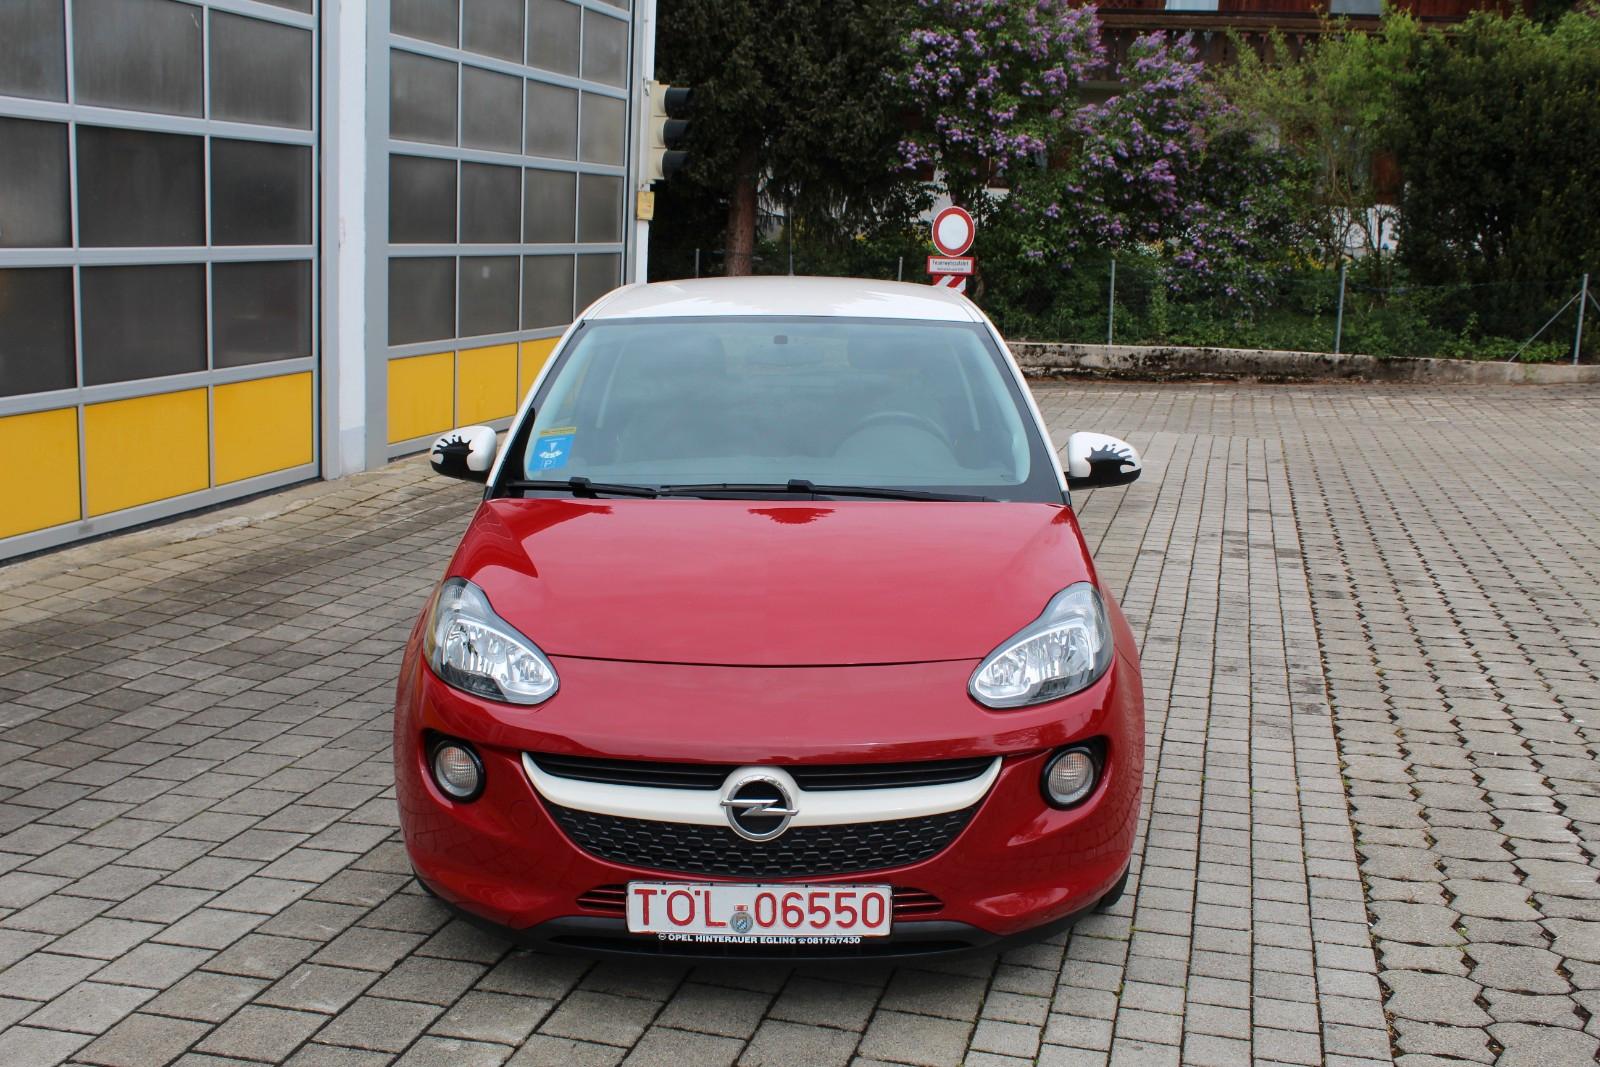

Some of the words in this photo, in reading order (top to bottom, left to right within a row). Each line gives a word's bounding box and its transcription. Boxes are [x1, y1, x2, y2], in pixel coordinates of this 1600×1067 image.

[634, 889, 727, 928] TÖL
[754, 892, 885, 929] 06550
[668, 933, 693, 942] OPEL
[695, 935, 758, 944] HINTERAUER
[760, 936, 797, 945] EGLING
[807, 936, 861, 945] 08176/7430
